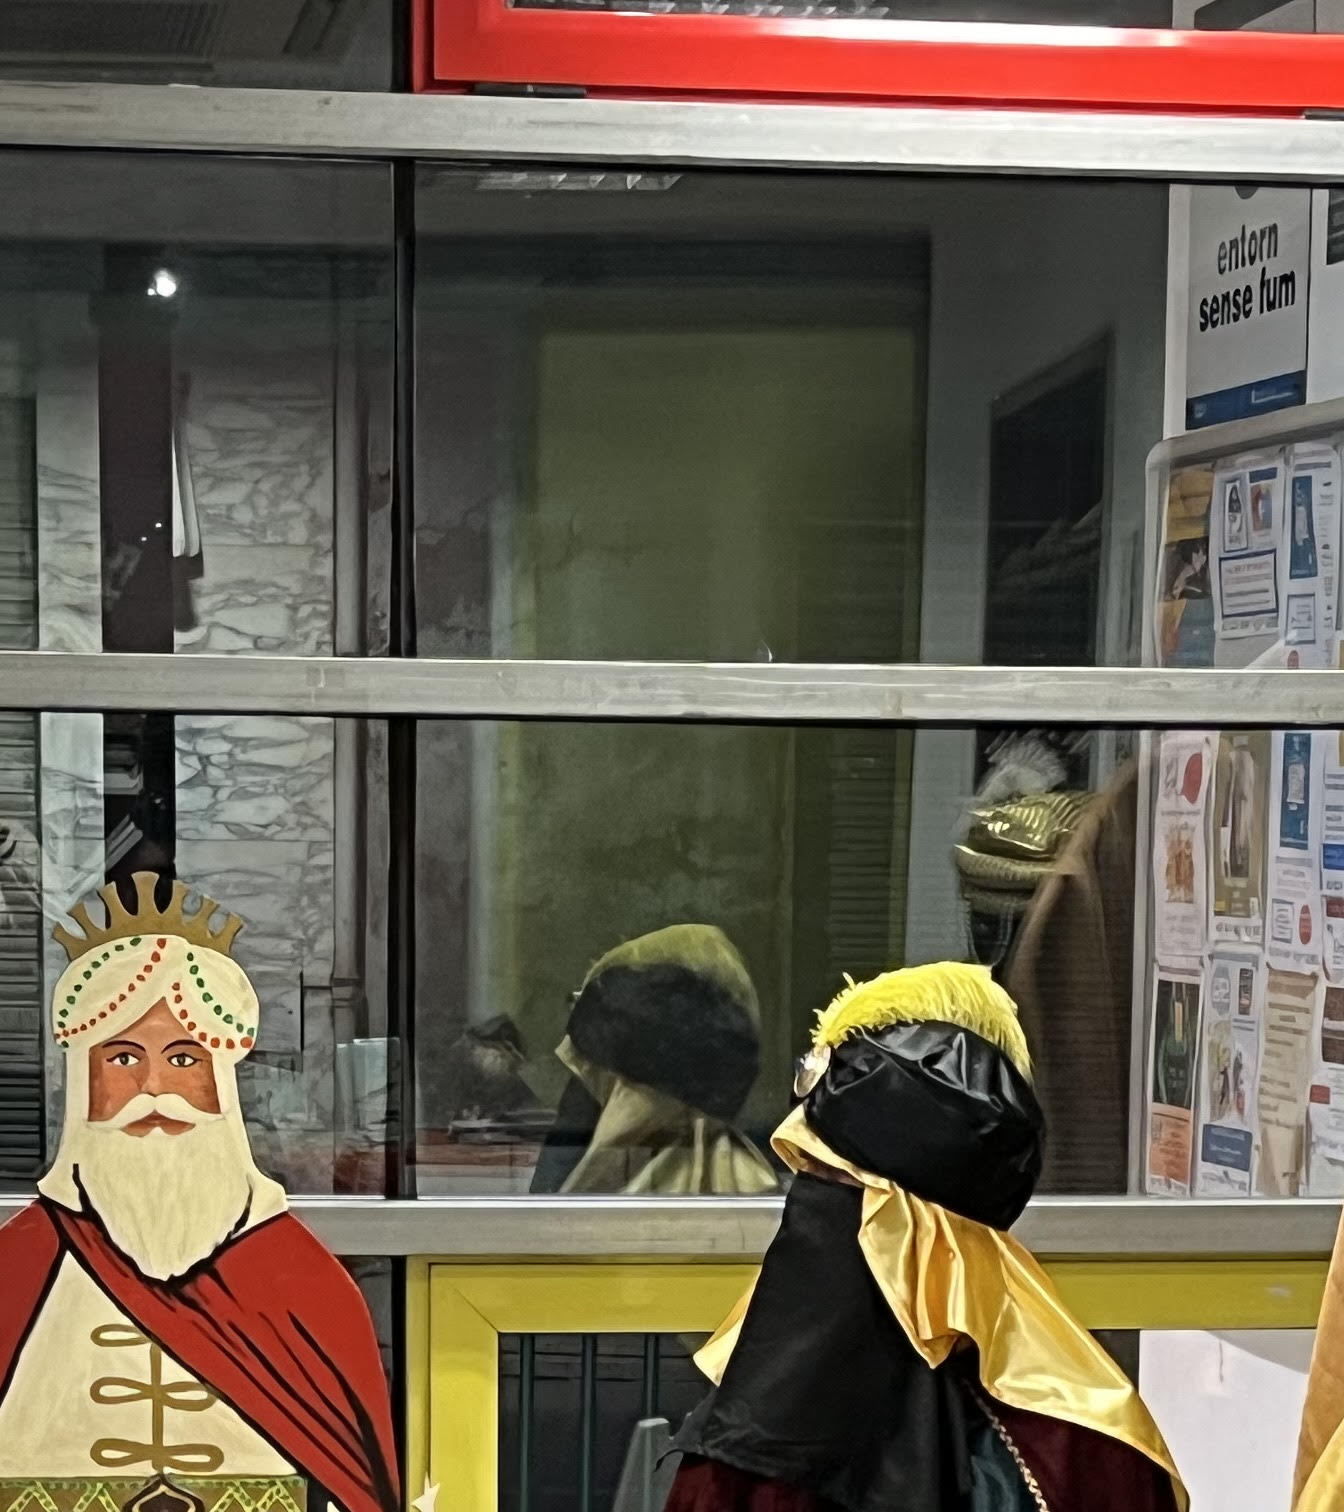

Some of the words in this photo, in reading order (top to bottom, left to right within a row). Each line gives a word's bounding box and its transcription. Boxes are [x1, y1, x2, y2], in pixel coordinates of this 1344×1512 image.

[1218, 222, 1278, 275] entorn
[1199, 284, 1253, 332] sense
[1260, 266, 1295, 314] fum
